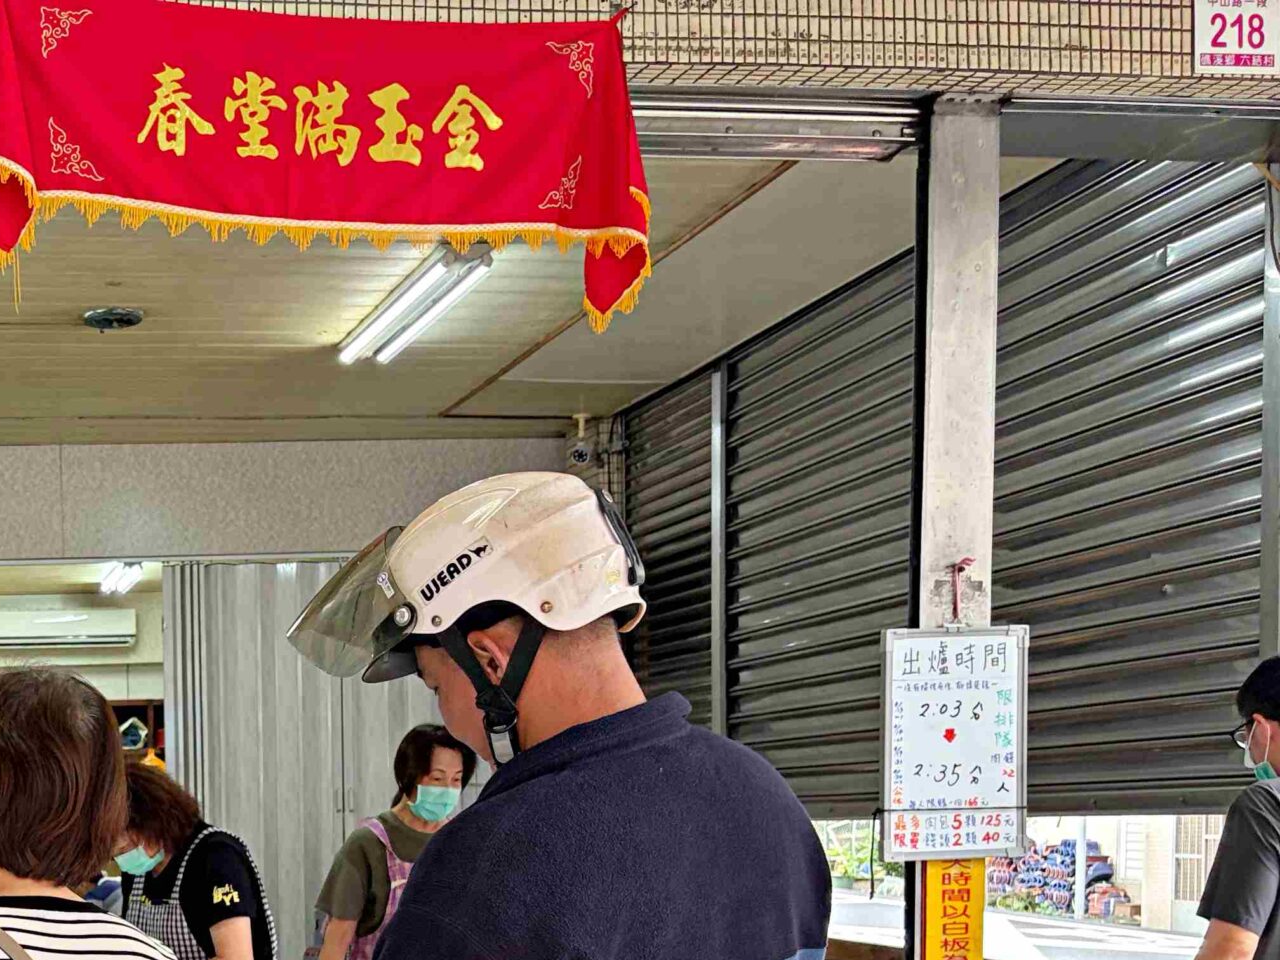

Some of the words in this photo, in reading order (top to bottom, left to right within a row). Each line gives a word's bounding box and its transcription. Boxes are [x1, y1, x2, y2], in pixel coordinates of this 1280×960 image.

[1210, 12, 1265, 49] 218
[420, 553, 472, 602] UJEAD
[902, 640, 1007, 675] 出爐時間
